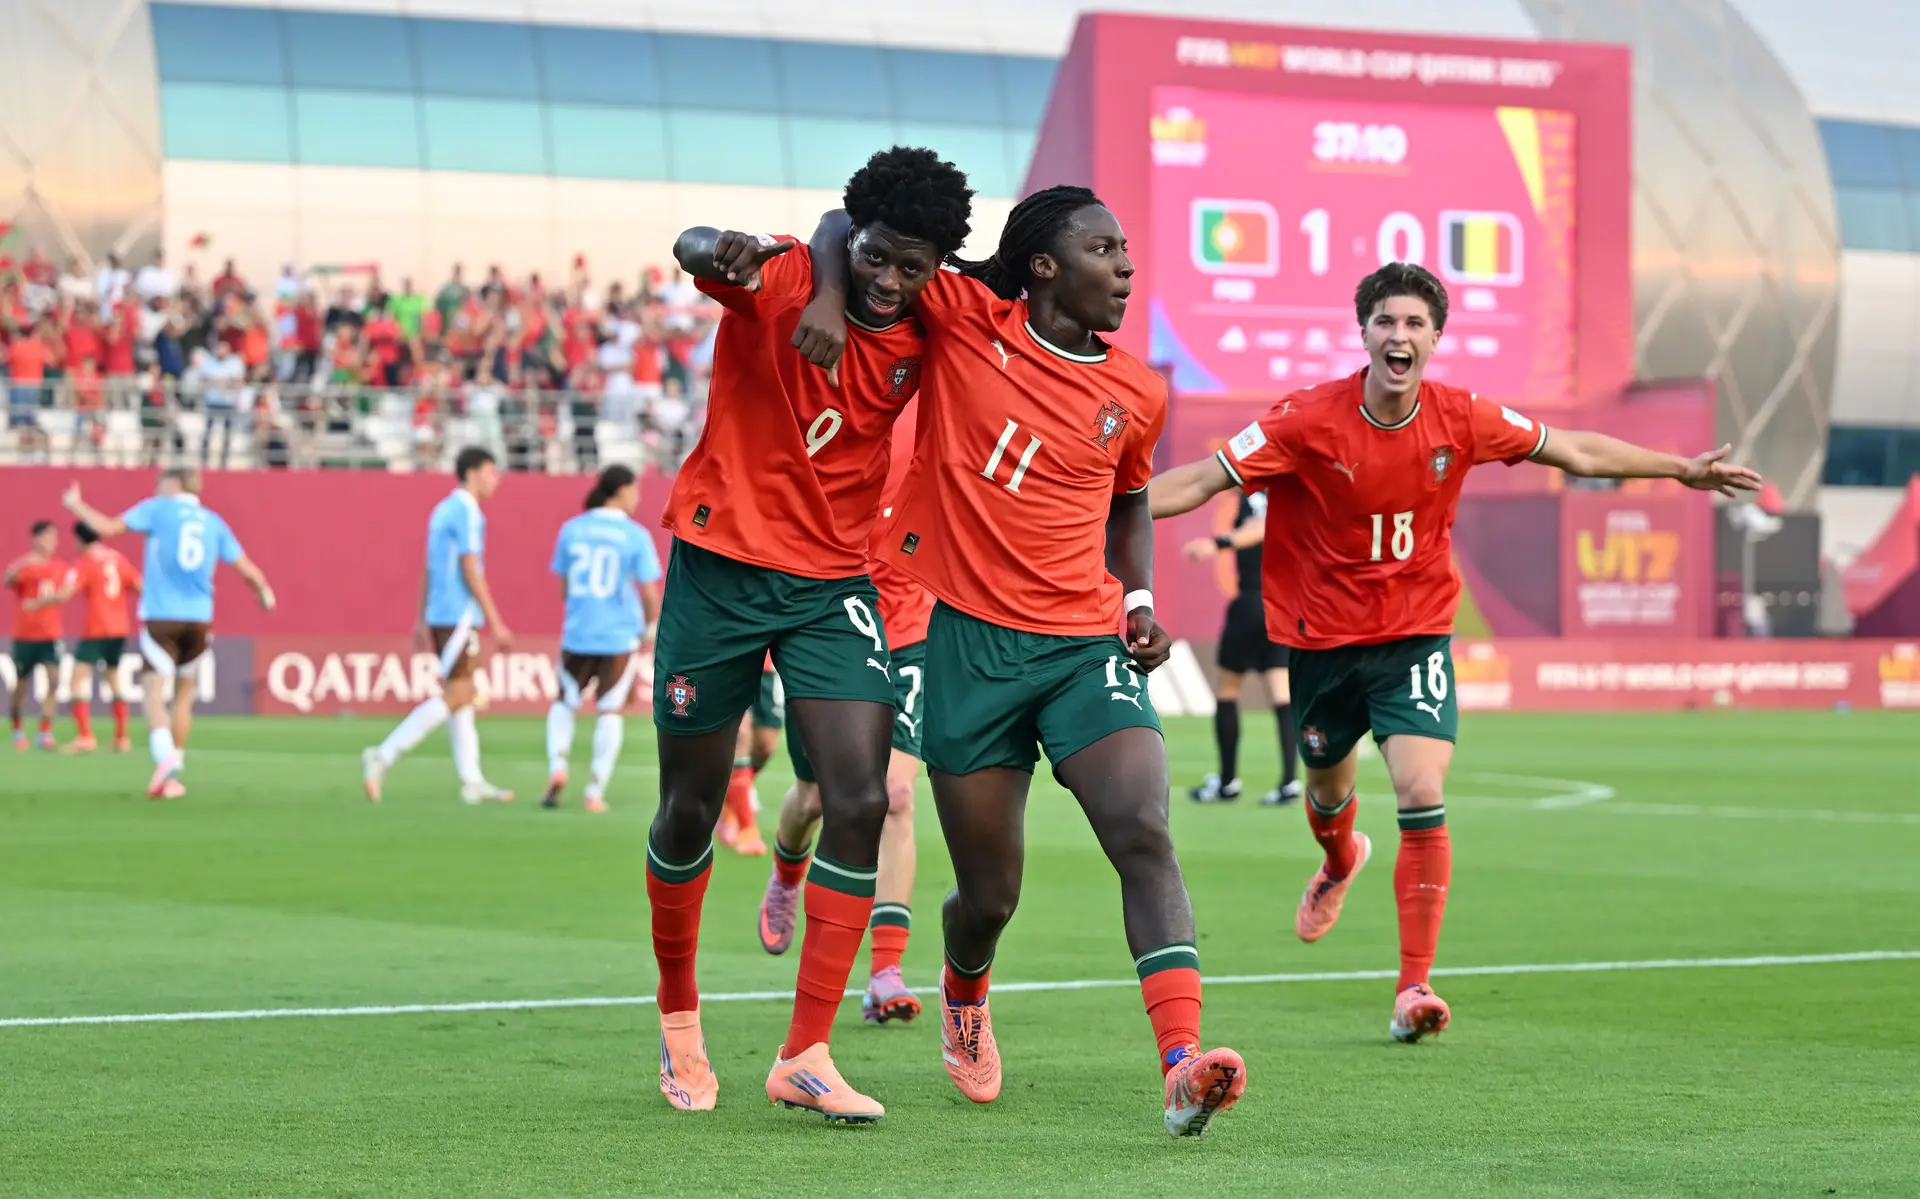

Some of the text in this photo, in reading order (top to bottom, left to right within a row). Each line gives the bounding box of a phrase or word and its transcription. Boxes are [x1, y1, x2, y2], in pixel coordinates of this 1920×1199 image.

[1300, 208, 1329, 275] 1
[1377, 211, 1425, 266] 0
[806, 408, 842, 456] 9
[981, 418, 1042, 494] 11
[176, 521, 206, 572] 6
[1370, 511, 1414, 561] 18
[567, 542, 621, 598] 20
[843, 595, 884, 652] 9
[267, 652, 447, 713] QATAR
[1409, 651, 1448, 700] 18
